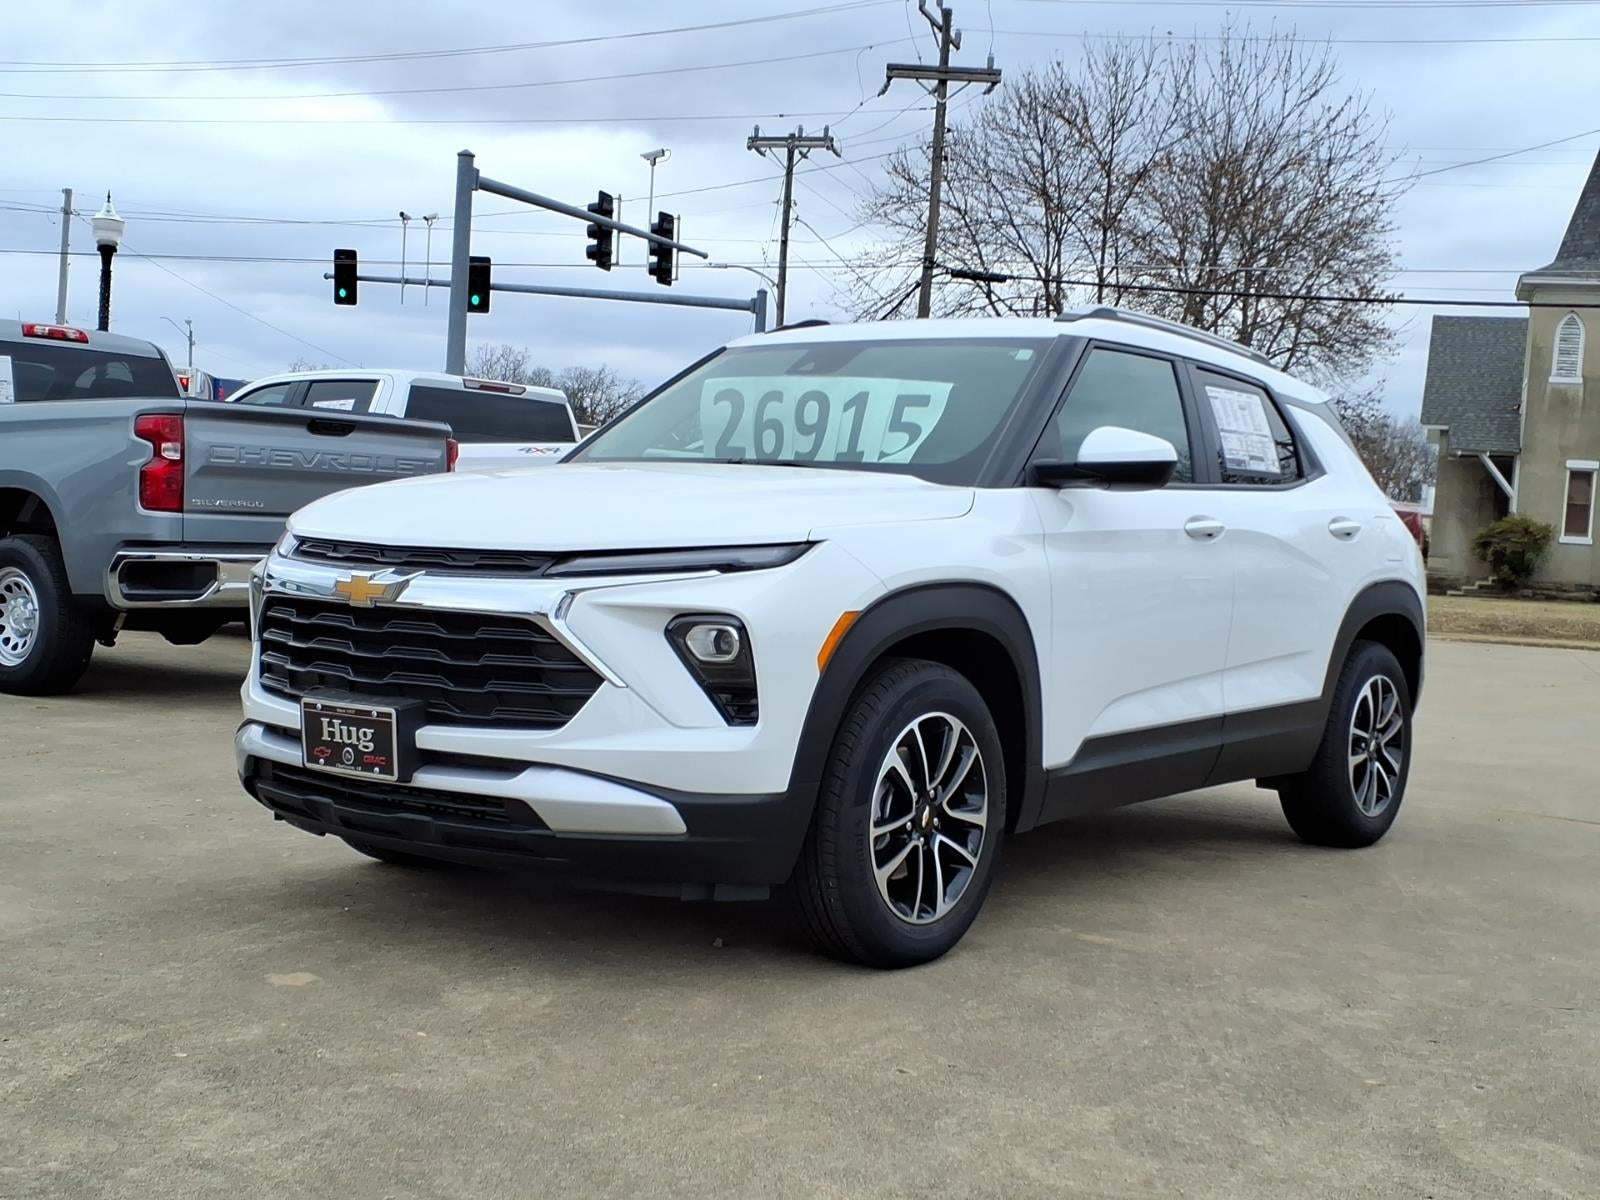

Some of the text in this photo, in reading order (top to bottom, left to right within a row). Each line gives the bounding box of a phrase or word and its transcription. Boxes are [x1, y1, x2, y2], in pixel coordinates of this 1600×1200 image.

[712, 388, 932, 462] 26915
[209, 445, 437, 475] CHEVROLET
[191, 498, 265, 508] SILVERADO
[320, 717, 375, 752] Hug
[362, 754, 387, 766] GMC
